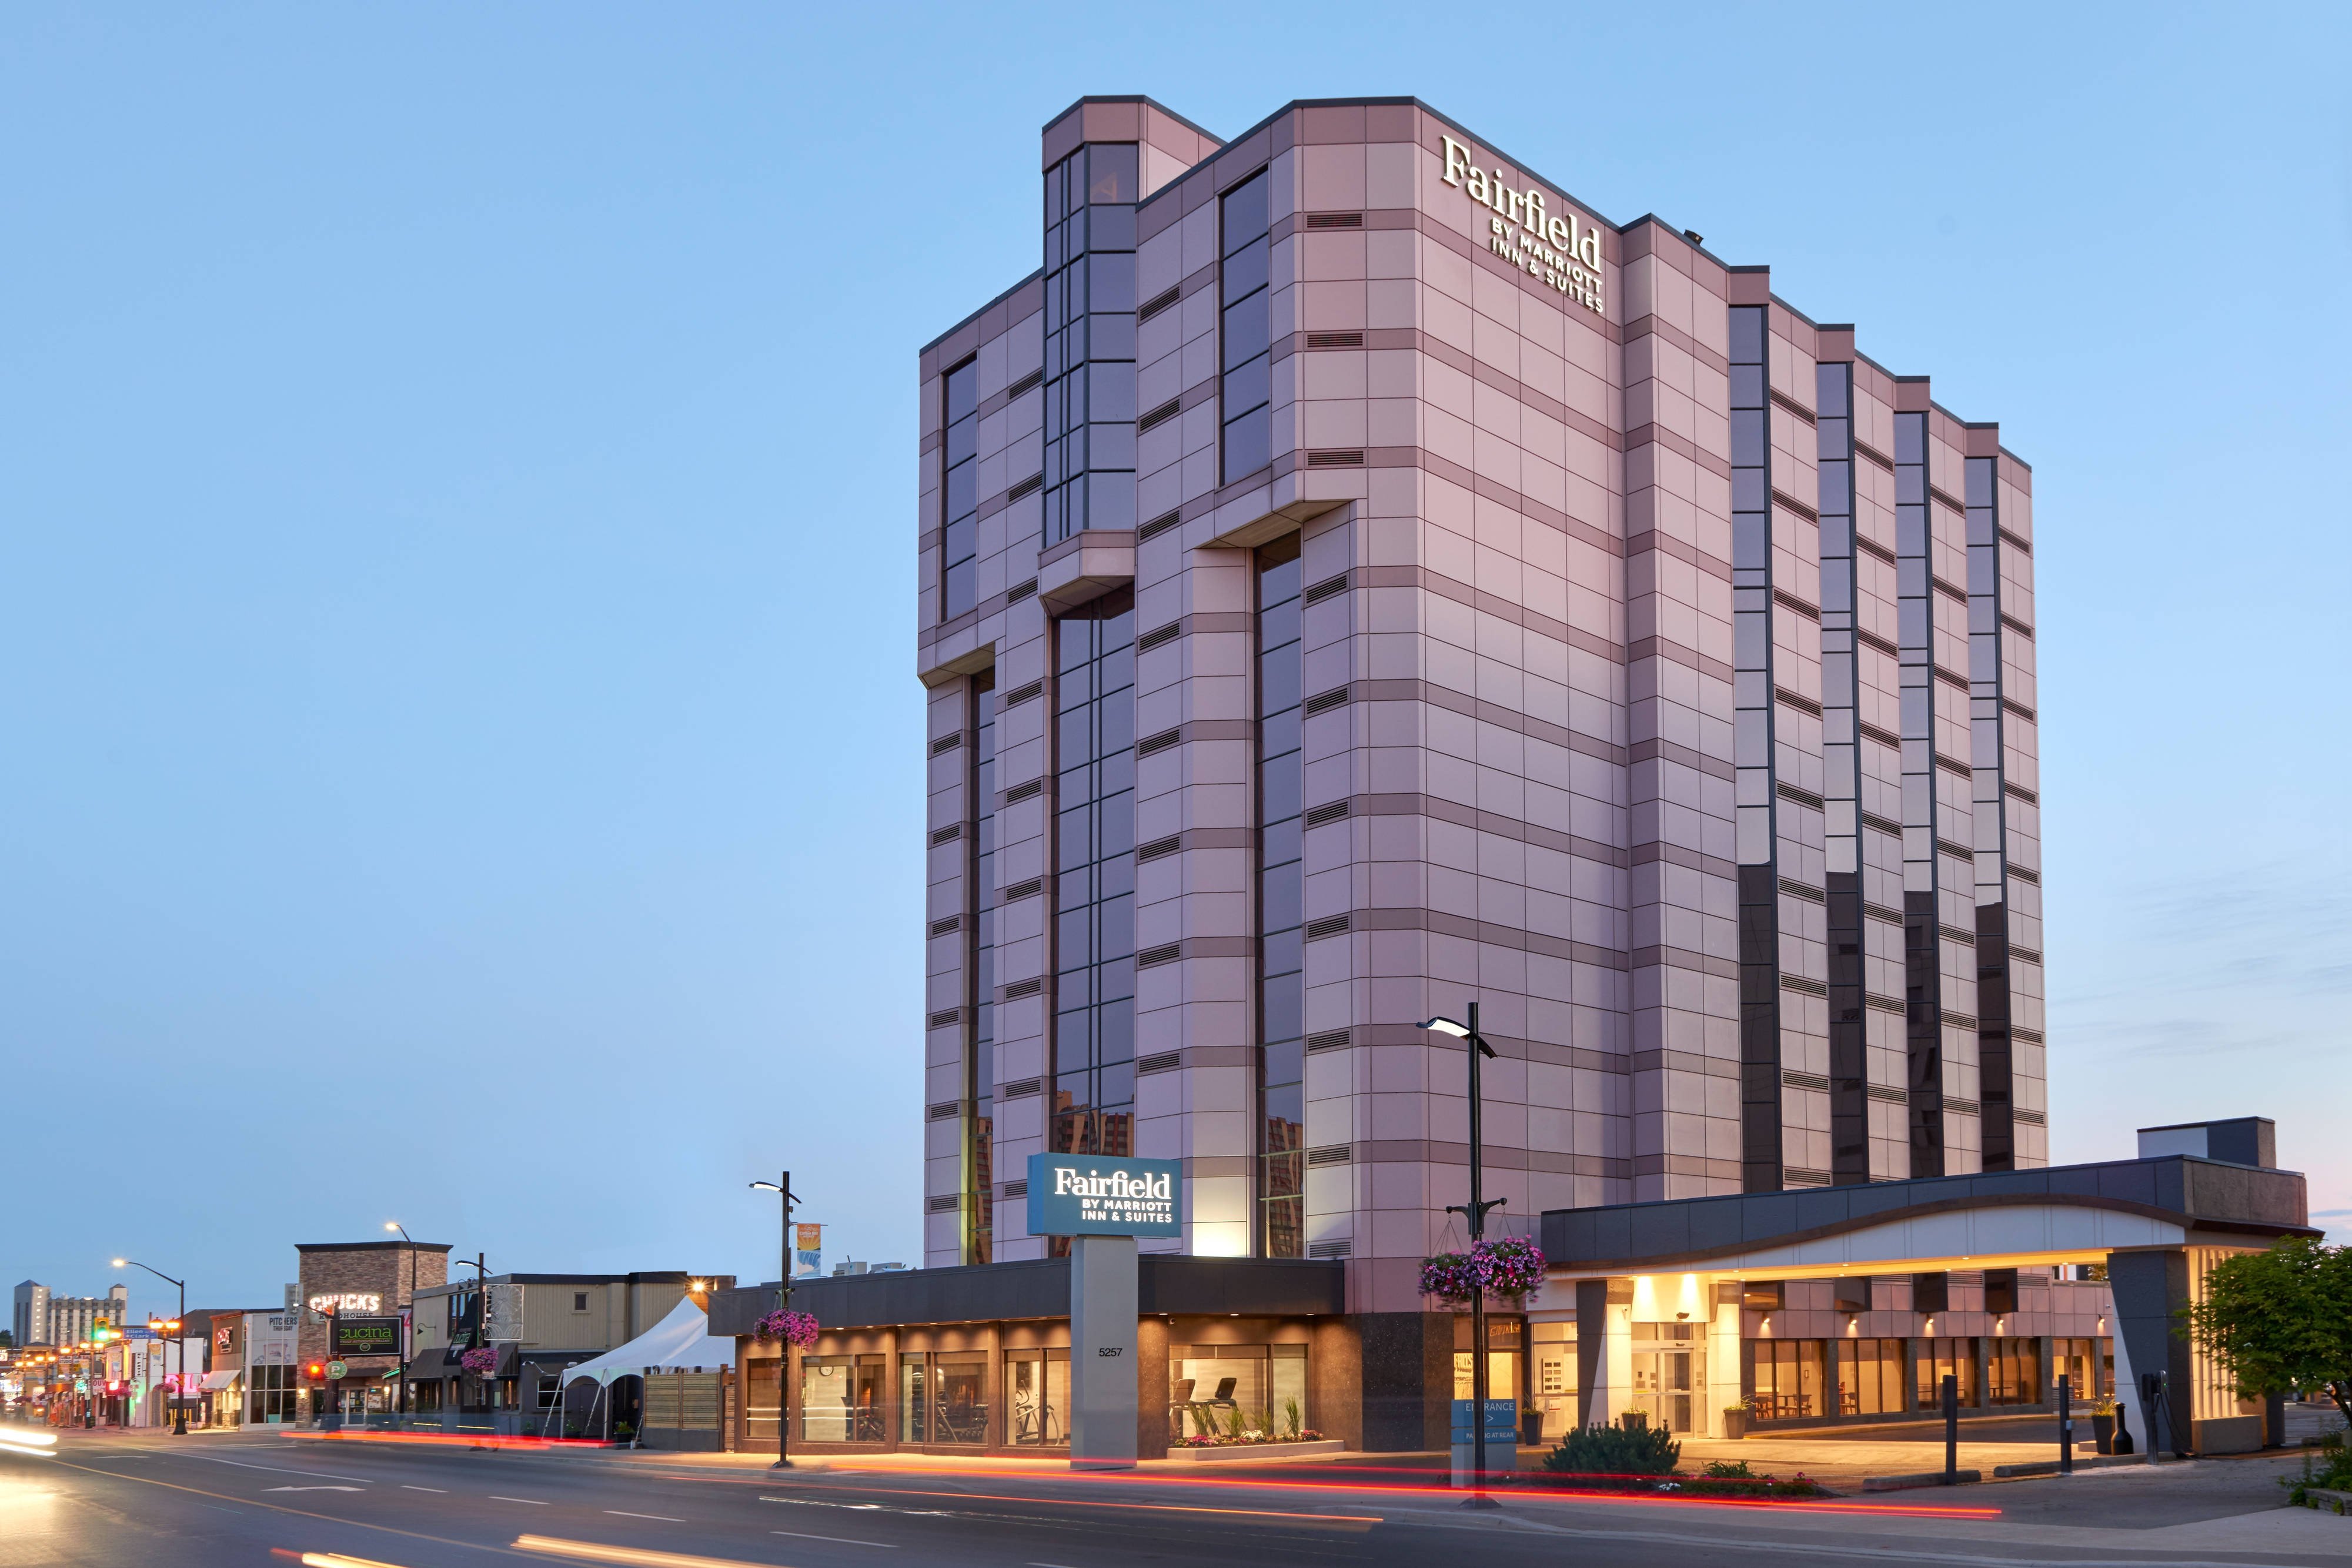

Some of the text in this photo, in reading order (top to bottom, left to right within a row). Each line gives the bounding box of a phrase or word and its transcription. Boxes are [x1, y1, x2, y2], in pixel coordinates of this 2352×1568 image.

[1441, 134, 1602, 274] Fairfield
[1490, 217, 1603, 294] BY MARRIOTT
[1490, 236, 1604, 313] INN & SUITES
[1054, 1167, 1172, 1200] Fairfield
[1081, 1199, 1172, 1212] BY MARRIOTT
[1081, 1210, 1172, 1223] INN & SUITES
[339, 1327, 393, 1339] cucina
[1098, 1347, 1123, 1358] 5257
[1466, 1403, 1514, 1411] ERANCE
